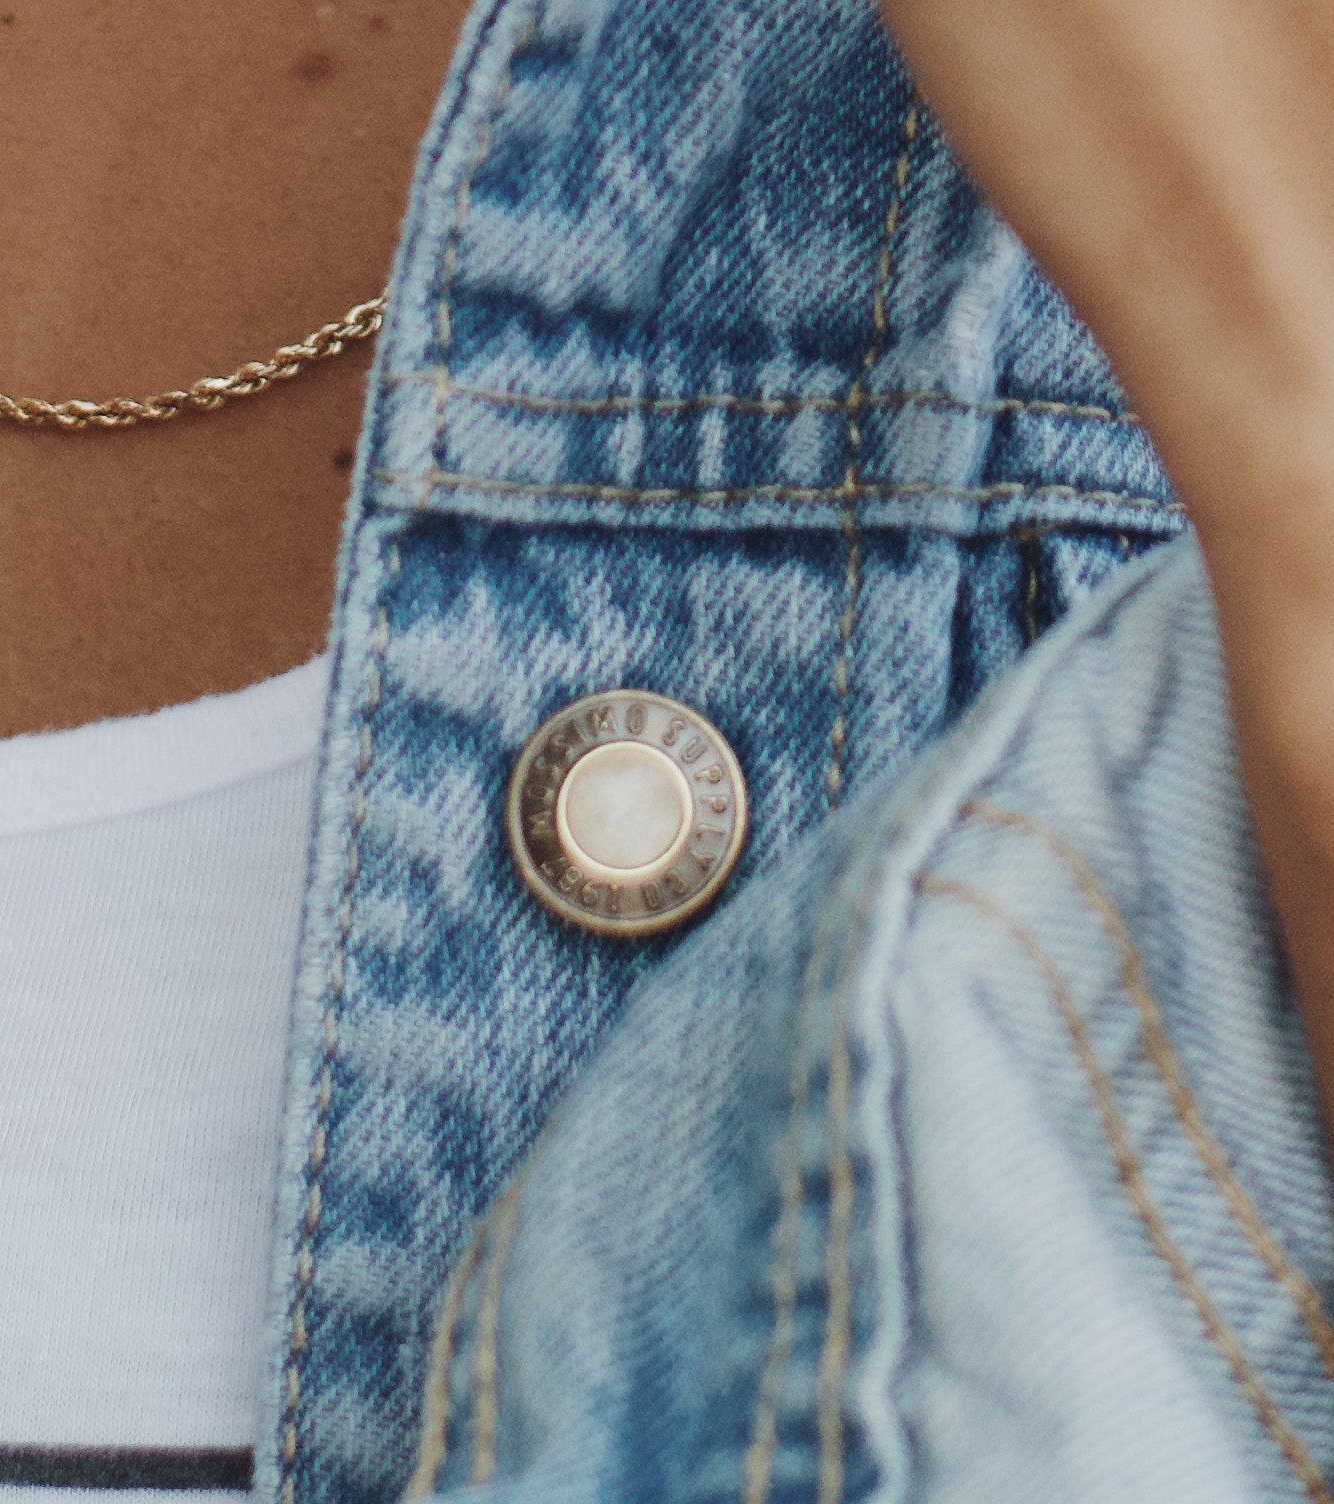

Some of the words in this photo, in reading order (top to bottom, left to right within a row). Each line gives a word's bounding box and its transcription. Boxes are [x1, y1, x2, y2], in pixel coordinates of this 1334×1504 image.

[523, 702, 647, 836] MOSSIMO
[661, 719, 727, 871] SUPPLY
[539, 856, 619, 914] 1987
